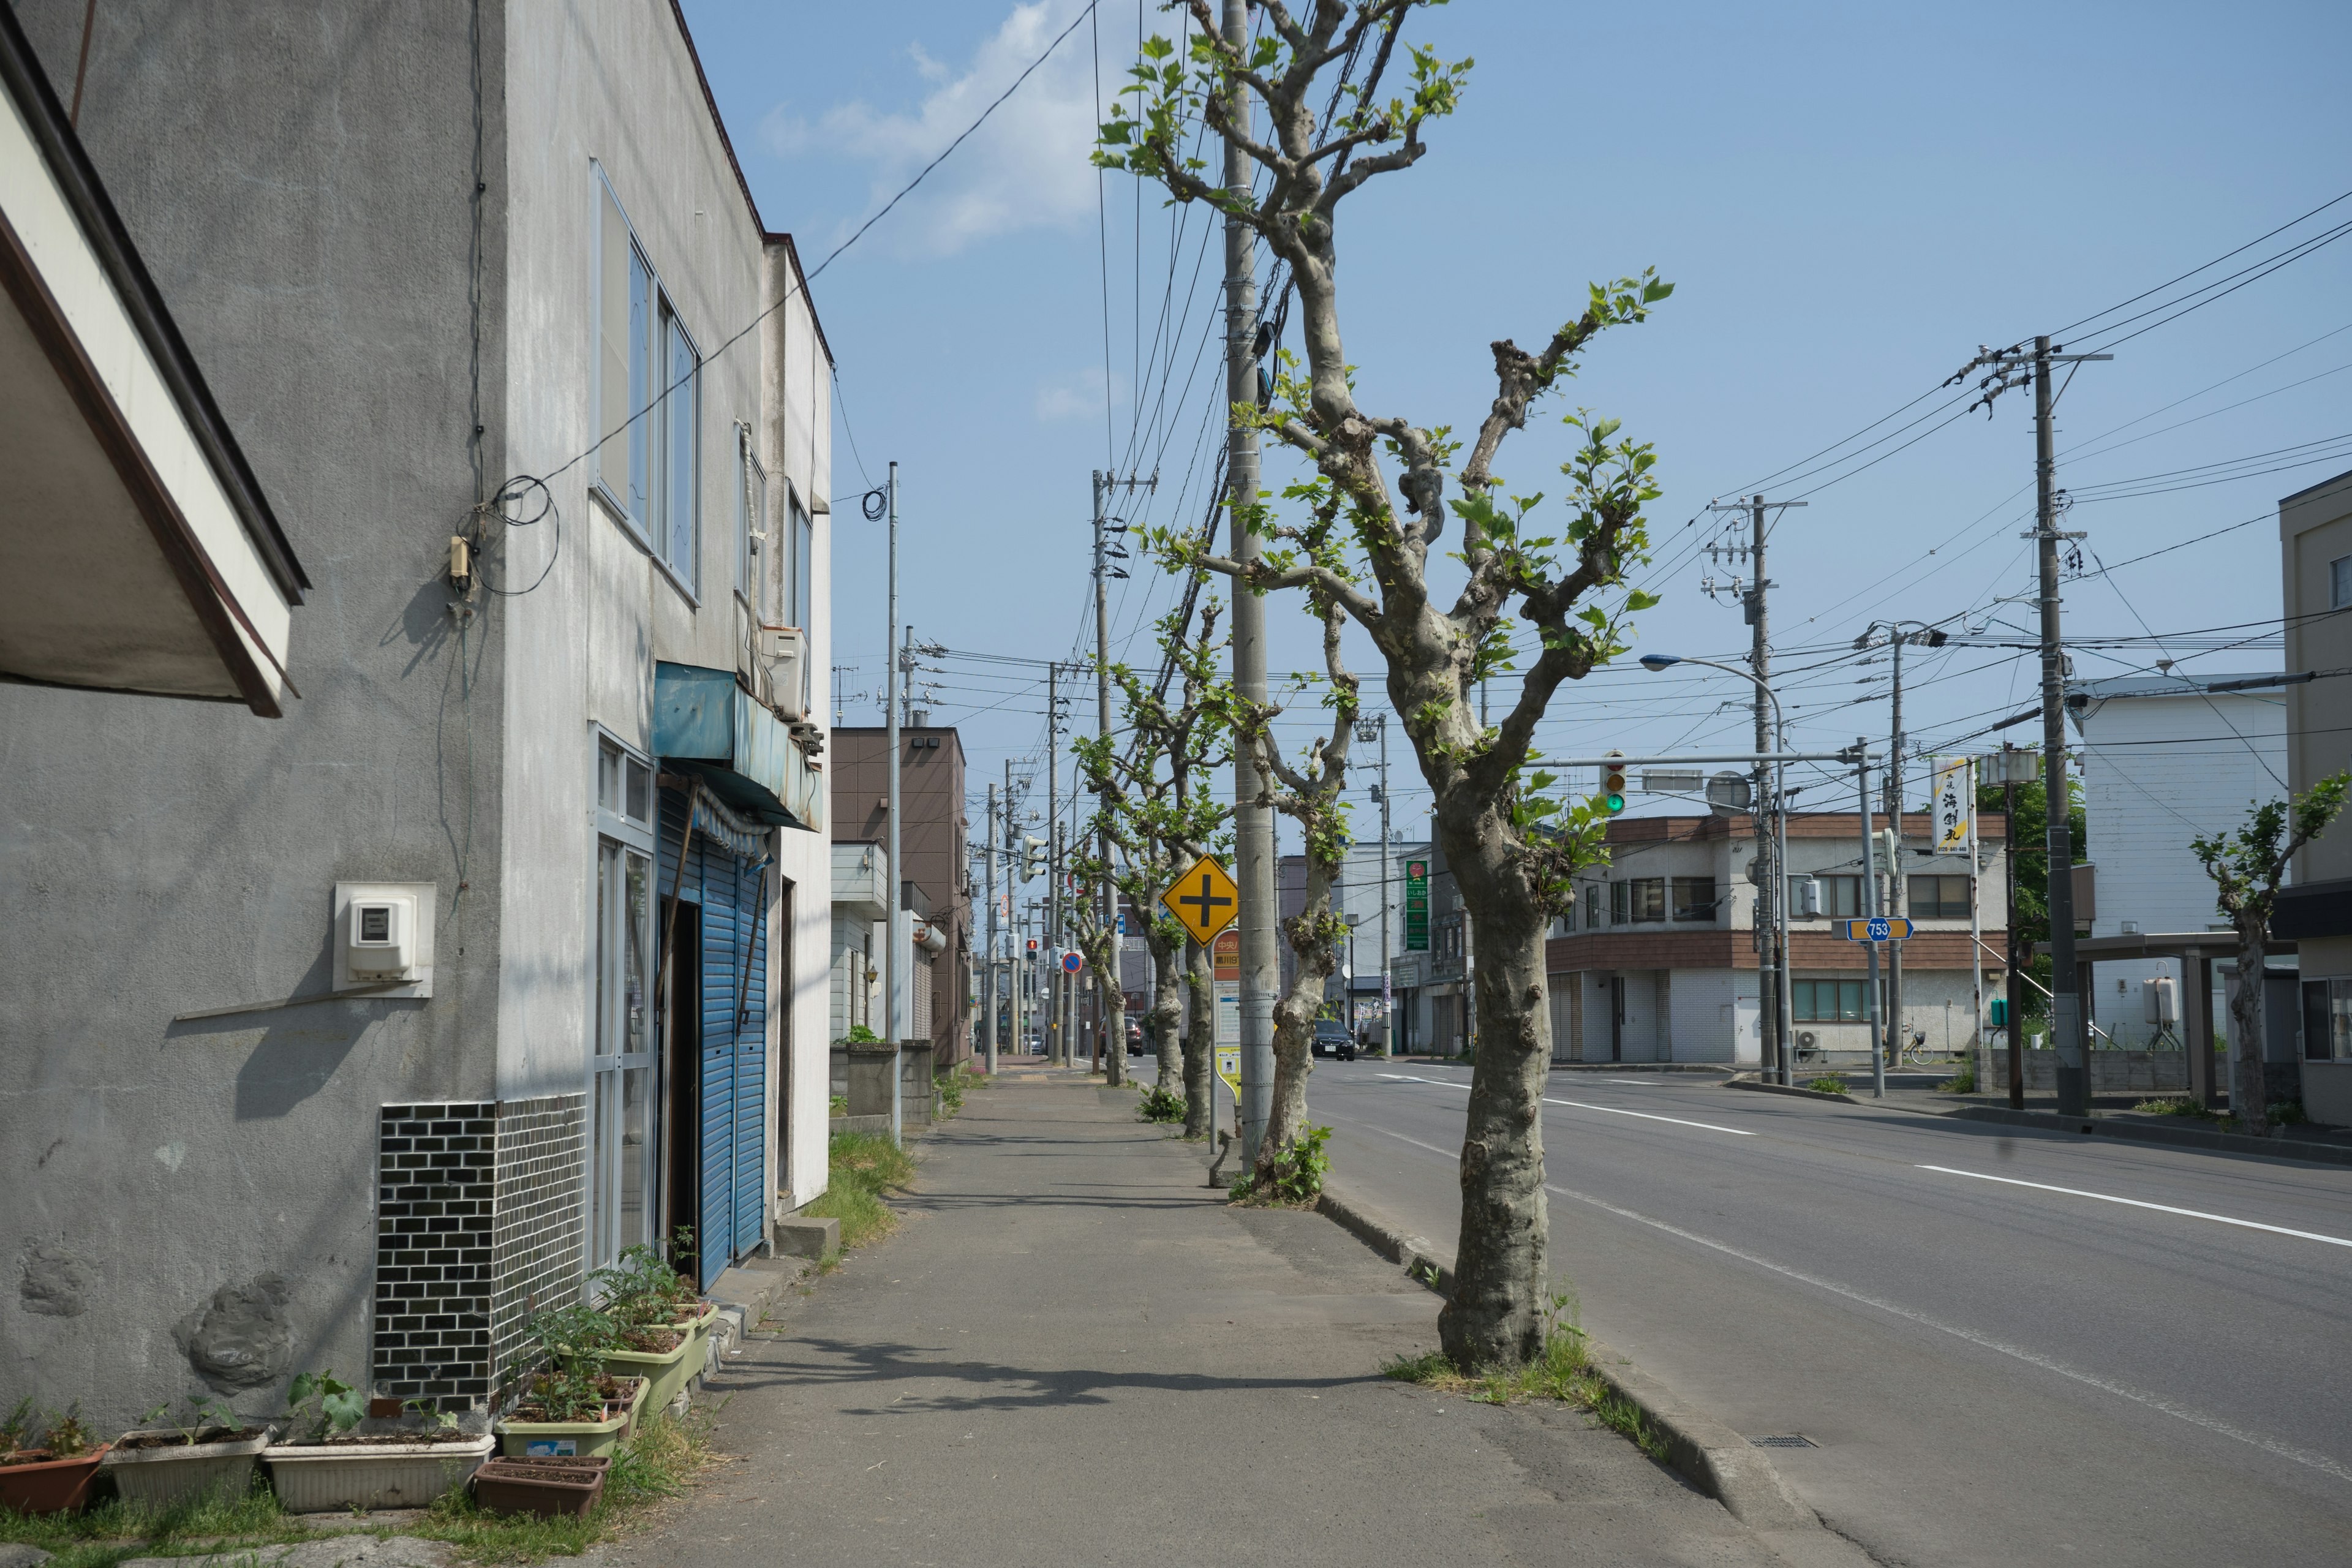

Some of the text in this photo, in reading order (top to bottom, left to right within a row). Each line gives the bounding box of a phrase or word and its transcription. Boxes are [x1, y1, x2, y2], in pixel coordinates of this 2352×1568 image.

[1943, 793, 1960, 841] 海鮮丸
[1411, 900, 1424, 909] 酒
[1869, 923, 1888, 935] 753
[1216, 956, 1239, 965] 黒川9
